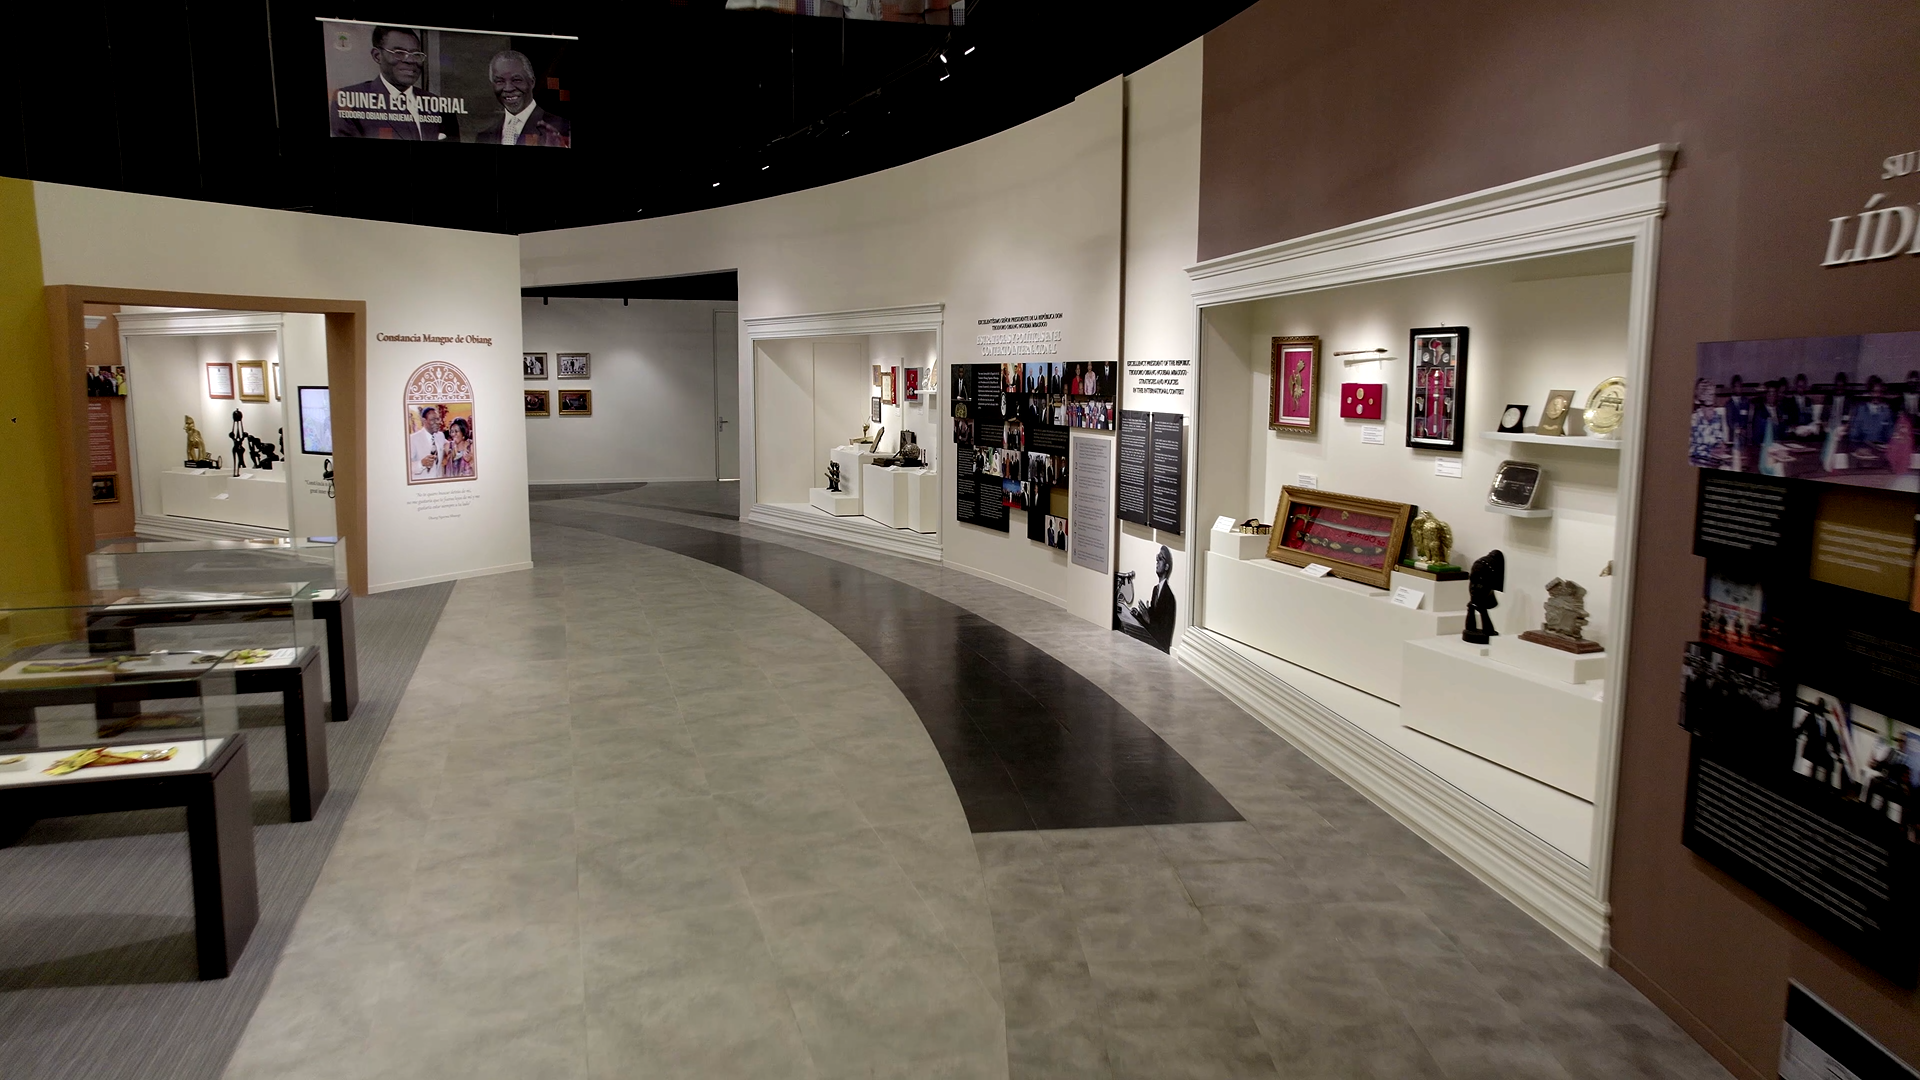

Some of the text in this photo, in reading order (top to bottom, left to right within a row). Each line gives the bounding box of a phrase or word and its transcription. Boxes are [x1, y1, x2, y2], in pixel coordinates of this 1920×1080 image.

[337, 90, 386, 110] GUINEA
[338, 110, 442, 124] TEODORO OBIANG NGUEMA BASOGO
[376, 332, 492, 346] Constancia Mangue de Obiang
